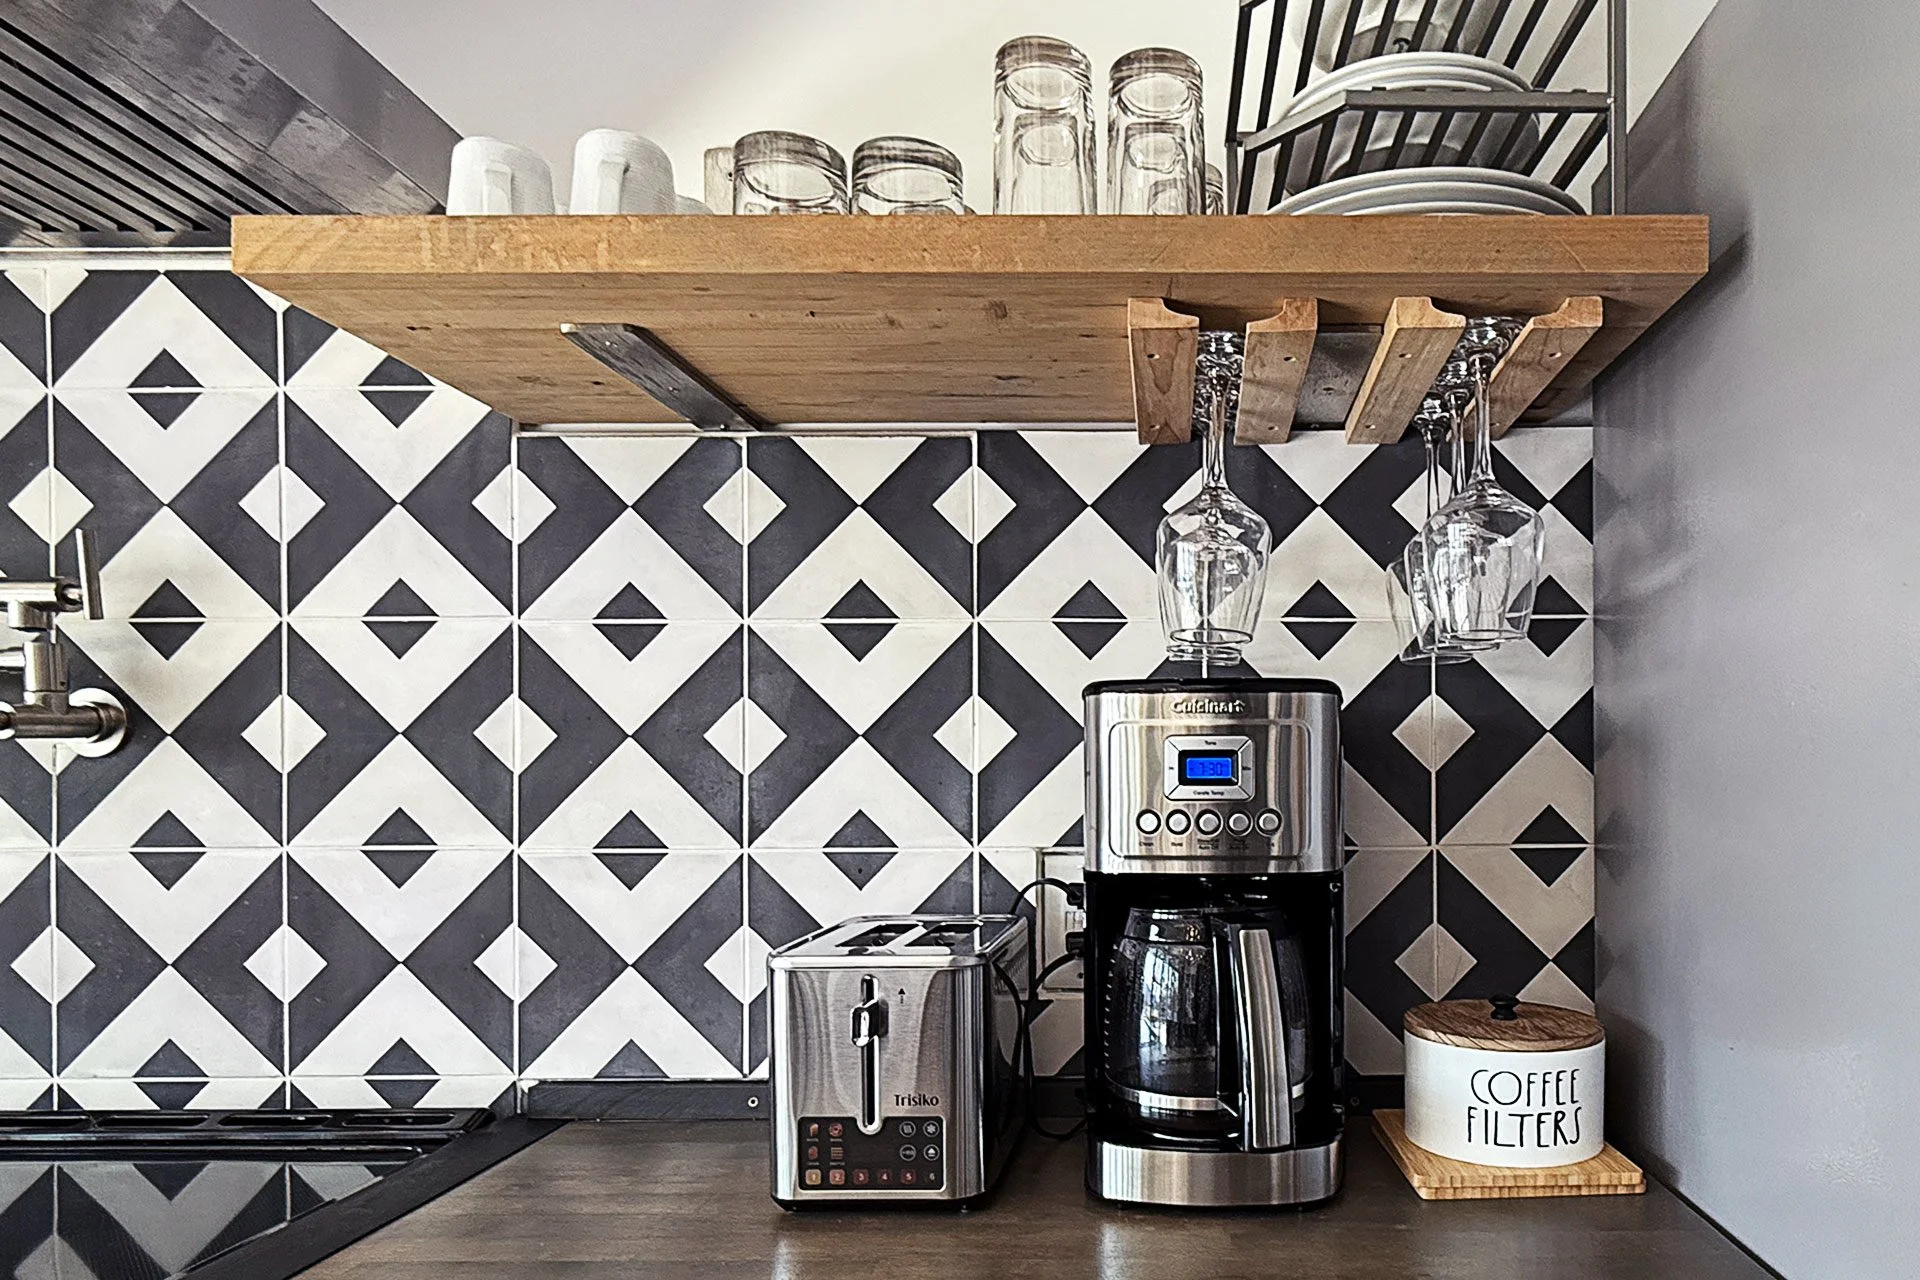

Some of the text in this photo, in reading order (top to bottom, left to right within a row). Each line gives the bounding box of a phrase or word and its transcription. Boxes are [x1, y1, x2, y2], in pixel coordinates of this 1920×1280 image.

[1170, 698, 1246, 714] Cuisinart
[1199, 762, 1223, 776] 7:30
[1470, 1068, 1580, 1107] COFFEE
[894, 1093, 940, 1107] Trisiko
[1467, 1106, 1582, 1148] FILTERS
